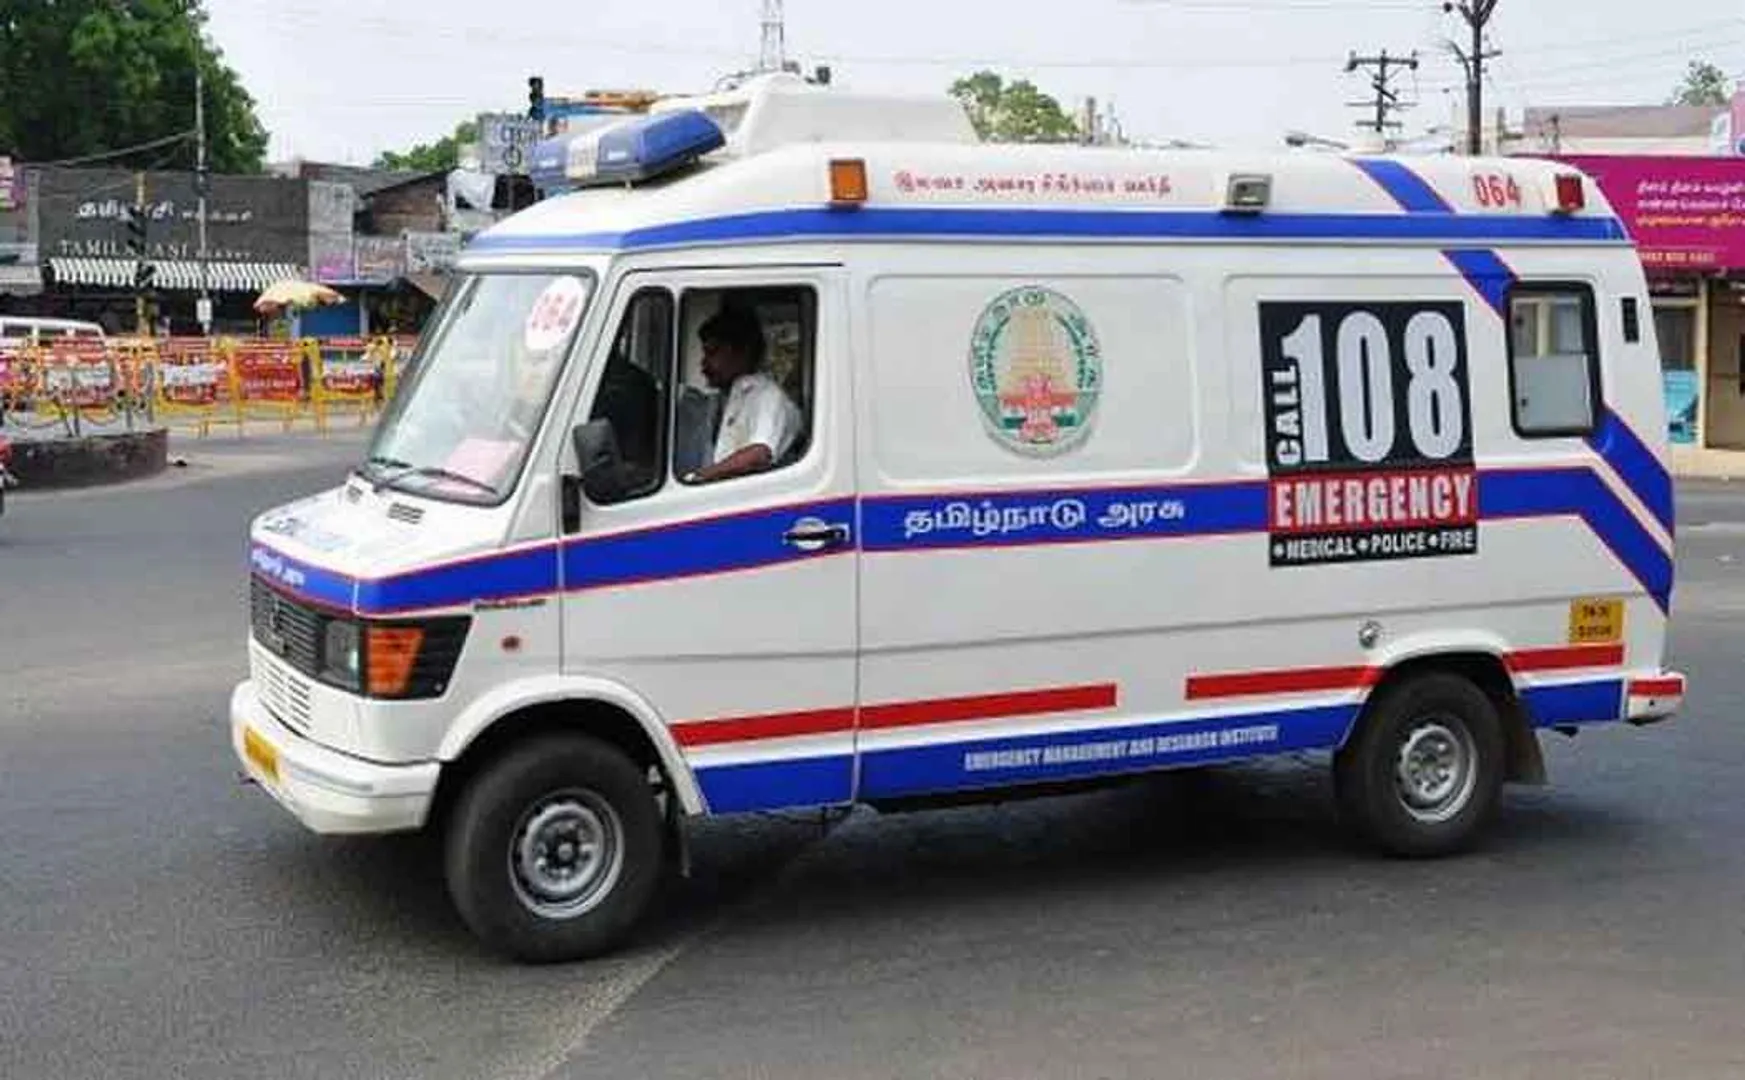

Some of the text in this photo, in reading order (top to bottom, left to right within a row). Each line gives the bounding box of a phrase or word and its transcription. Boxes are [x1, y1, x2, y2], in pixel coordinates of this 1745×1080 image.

[1472, 173, 1521, 208] 064
[1281, 310, 1464, 463] 108
[1272, 365, 1302, 466] CALL
[904, 499, 1086, 539] தமிழ்நாடு
[1274, 474, 1473, 528] EMERGENCY
[1286, 530, 1475, 560] MEDICAL POLICE FIRE
